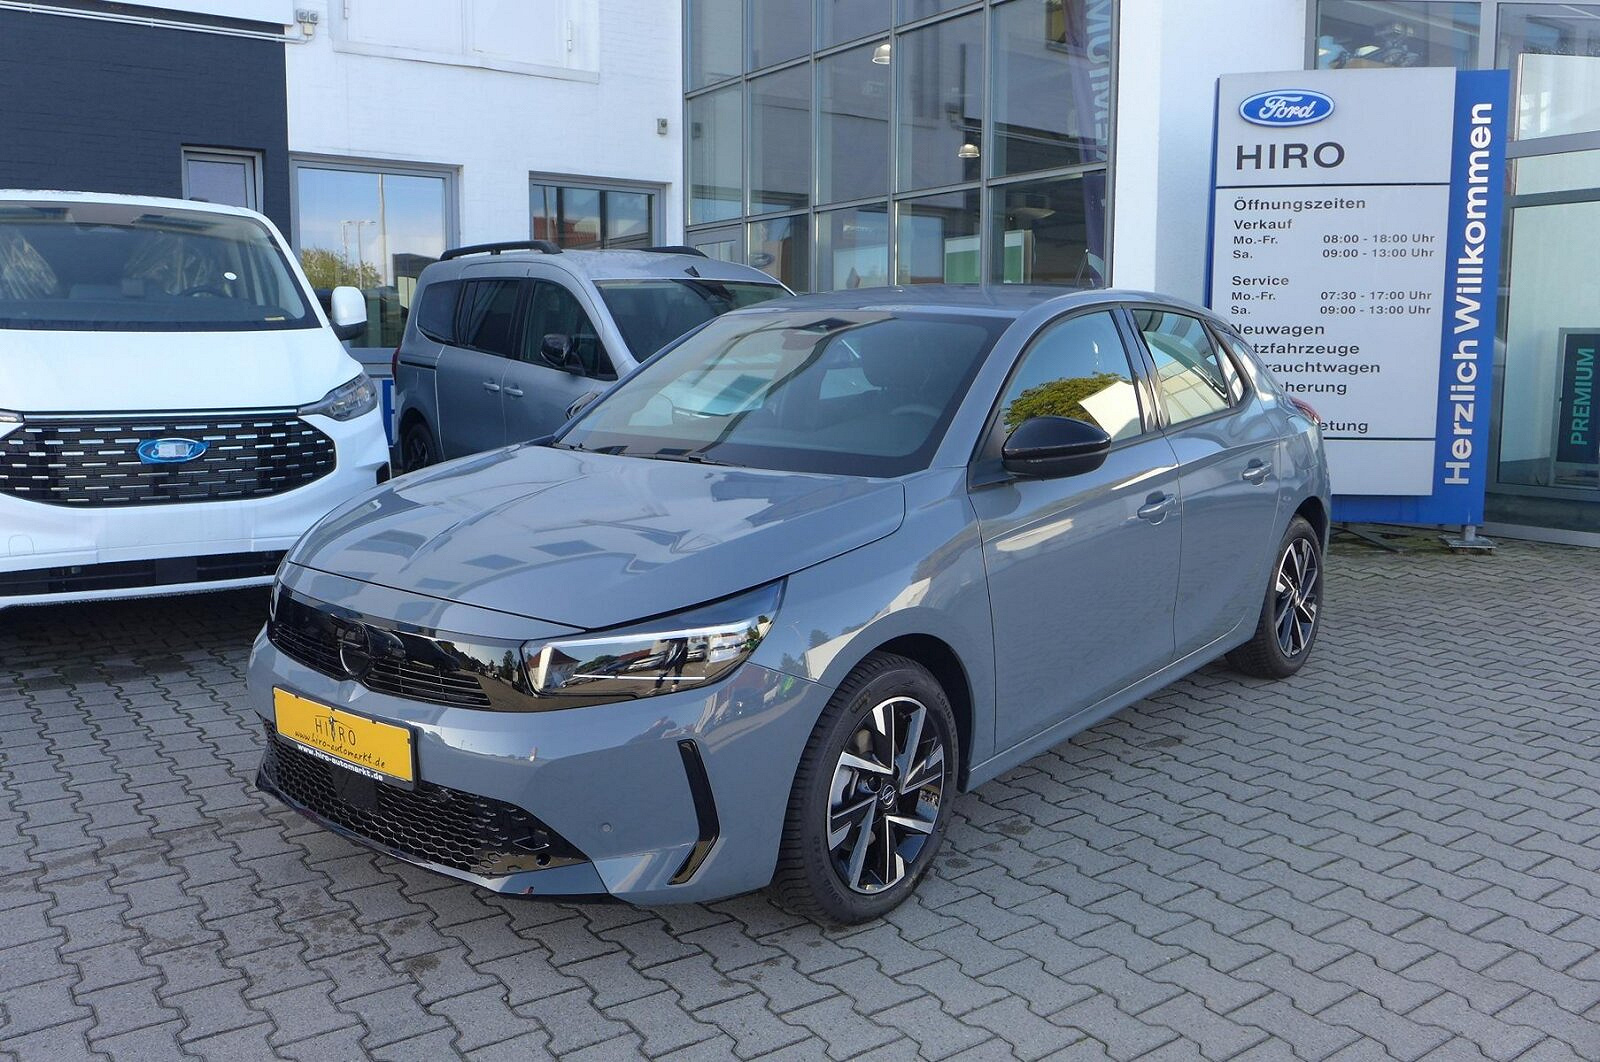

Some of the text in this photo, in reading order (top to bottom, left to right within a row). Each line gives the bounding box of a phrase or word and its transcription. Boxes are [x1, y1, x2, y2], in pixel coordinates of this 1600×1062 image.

[1258, 95, 1317, 119] Ford
[1236, 141, 1345, 171] HIRO
[1233, 196, 1366, 213] Öffnungszeiten
[1233, 218, 1293, 230] Verkauf
[1233, 234, 1278, 245] Mo.-Fr.
[1323, 234, 1360, 244] 08:00
[1372, 233, 1408, 243] 18:00
[1412, 233, 1435, 243] Uhr
[1232, 249, 1253, 259] Sa.
[1322, 248, 1359, 258] 09:00
[1372, 248, 1407, 258] 13:00
[1411, 248, 1434, 258] Uhr
[1231, 275, 1290, 286] Service
[1231, 291, 1276, 301] Mo.-Fr.
[1320, 291, 1357, 301] 07:30
[1369, 290, 1405, 300] 17:00
[1409, 290, 1432, 300] Uhr
[1444, 103, 1492, 485] Herzlich Willkommen
[1230, 305, 1251, 315] Sa.
[1319, 305, 1356, 315] 09:00
[1369, 305, 1404, 315] 13:00
[1408, 305, 1432, 315] Uhr
[1232, 323, 1325, 338] Neuwagen
[1253, 343, 1360, 356] tzfahrzeuge
[1282, 382, 1348, 396] herung
[1571, 348, 1595, 445] PREMIUM
[1321, 421, 1369, 434] etung
[314, 717, 356, 746] HIRO
[295, 731, 385, 768] www.hiro-automarkt.de
[297, 744, 383, 781] www.hiro-automarkt.de
